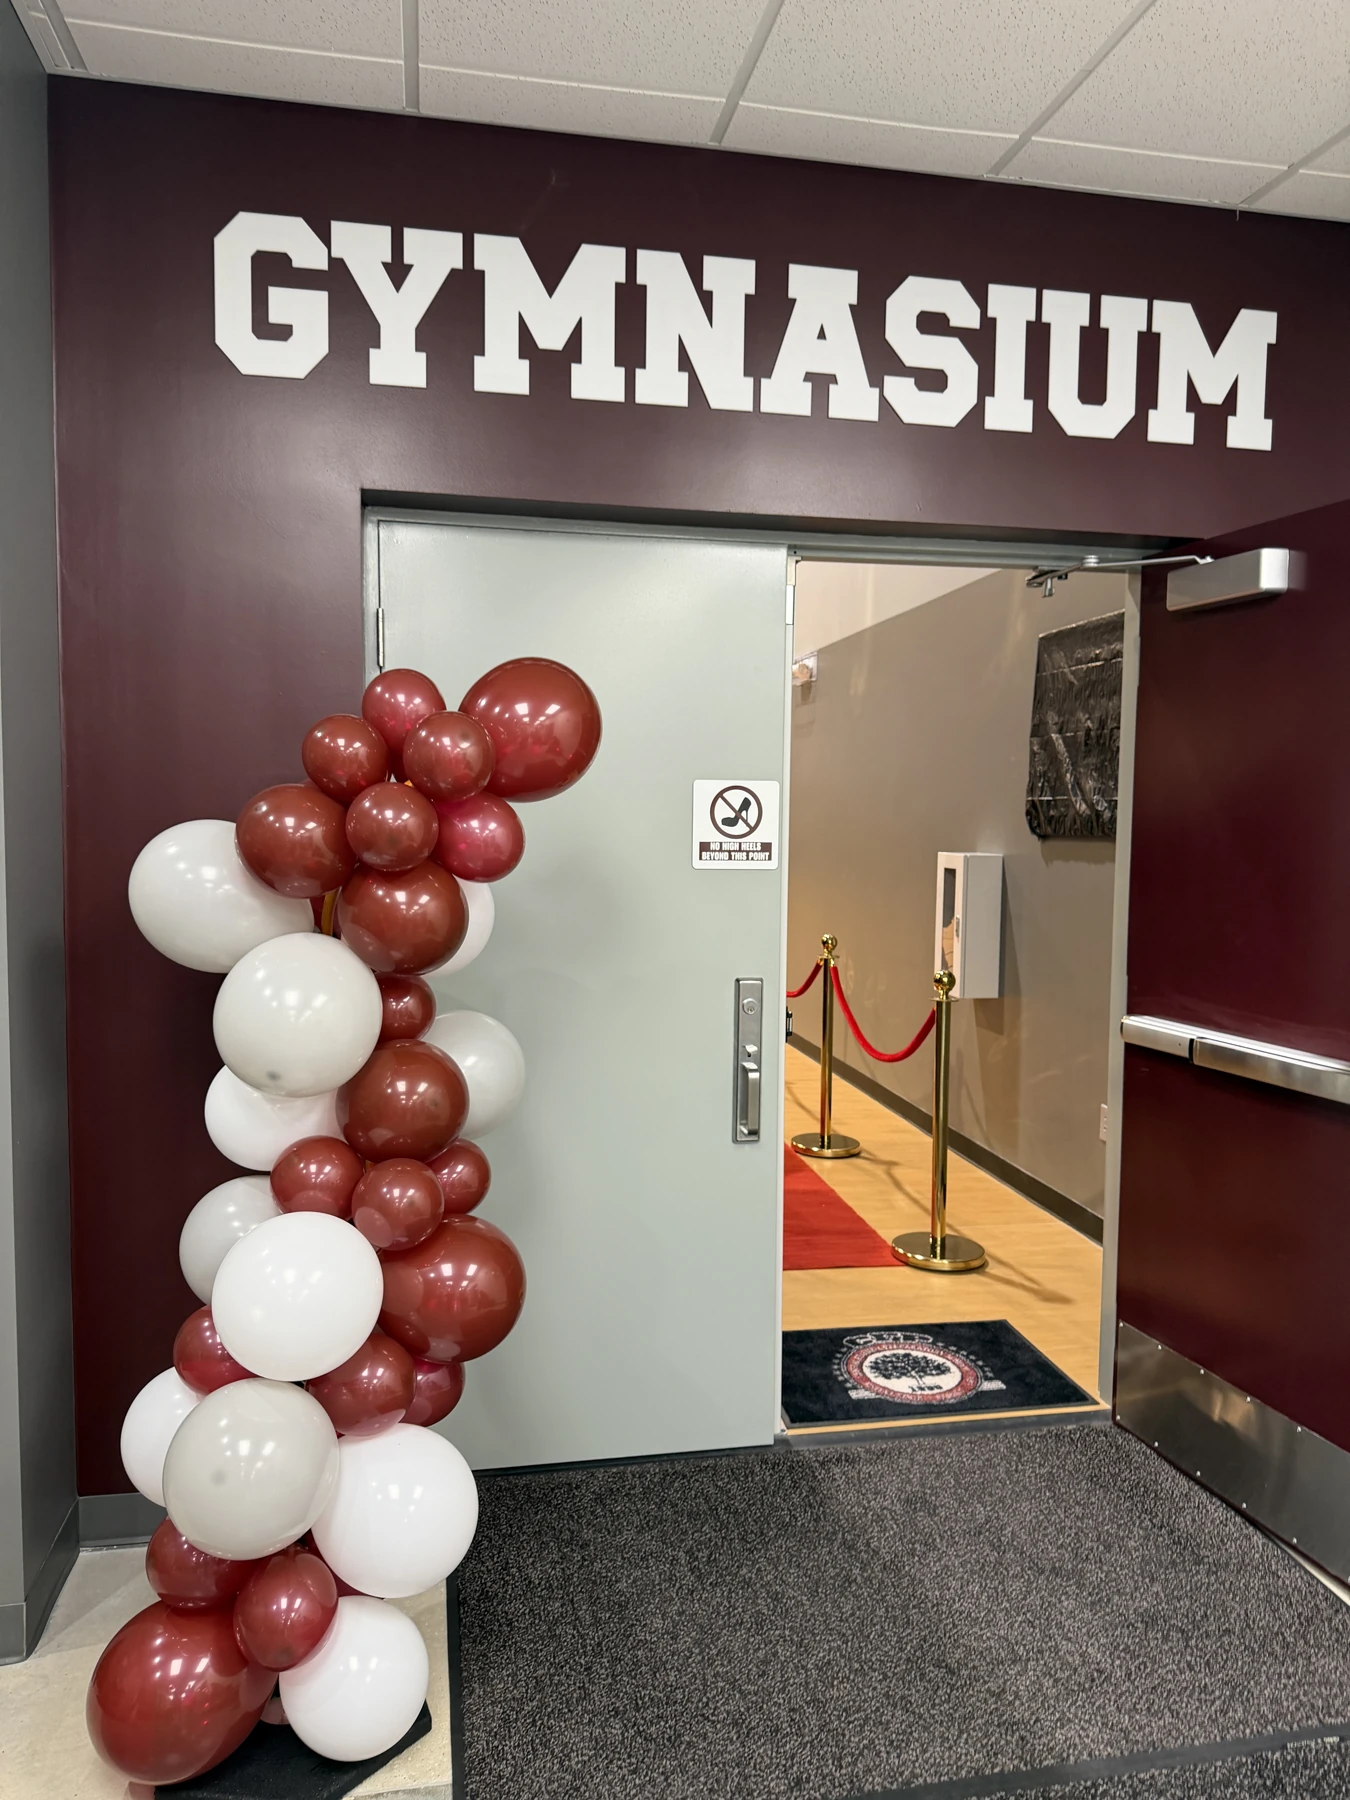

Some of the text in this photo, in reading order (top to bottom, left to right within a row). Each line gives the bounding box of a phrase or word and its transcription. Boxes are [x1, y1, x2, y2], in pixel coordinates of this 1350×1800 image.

[213, 211, 1278, 451] GYMNASIUM
[710, 842, 761, 851] NO HIGH HEELS
[701, 851, 769, 861] BEYOND THIS POINT
